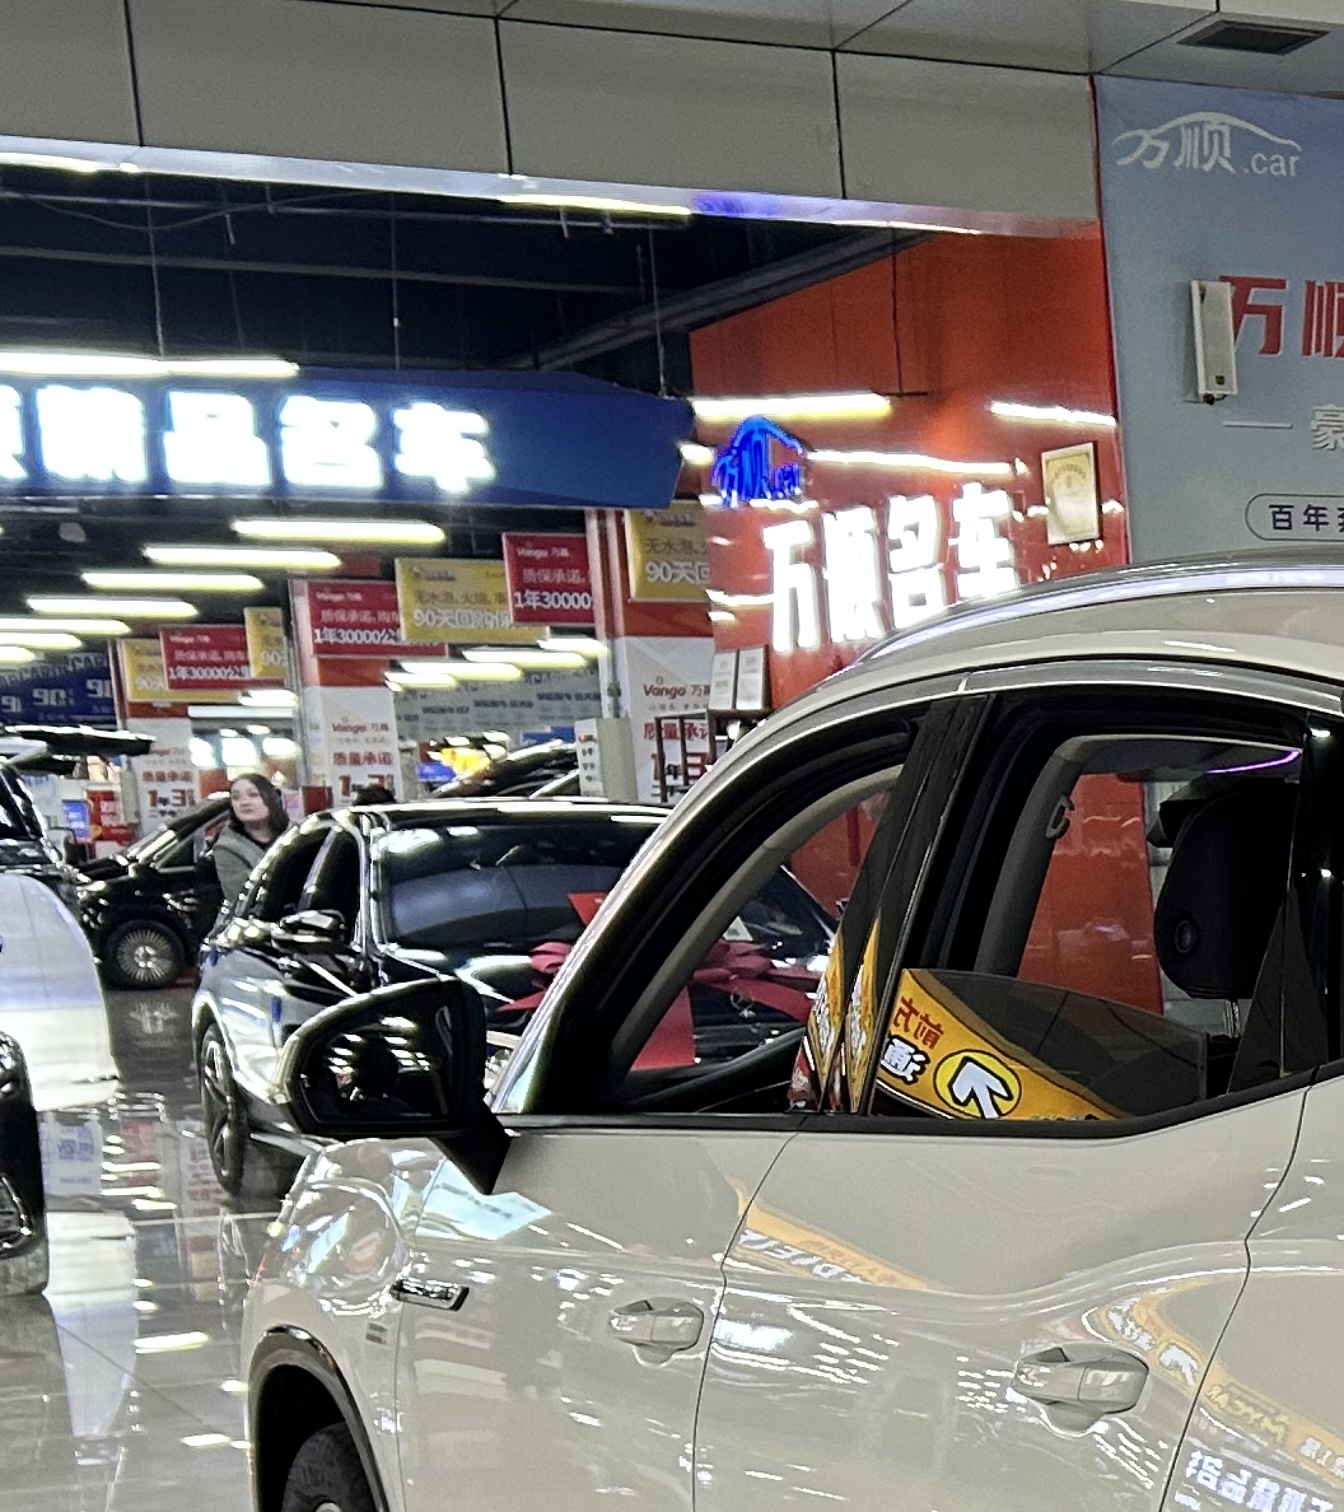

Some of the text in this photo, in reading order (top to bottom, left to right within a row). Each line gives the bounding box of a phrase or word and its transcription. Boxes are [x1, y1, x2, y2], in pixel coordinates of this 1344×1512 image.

[1113, 113, 1236, 174] 万顺
[0, 384, 497, 494] 精品名车
[763, 482, 1021, 651] 万顺名车
[643, 684, 686, 699] Vango
